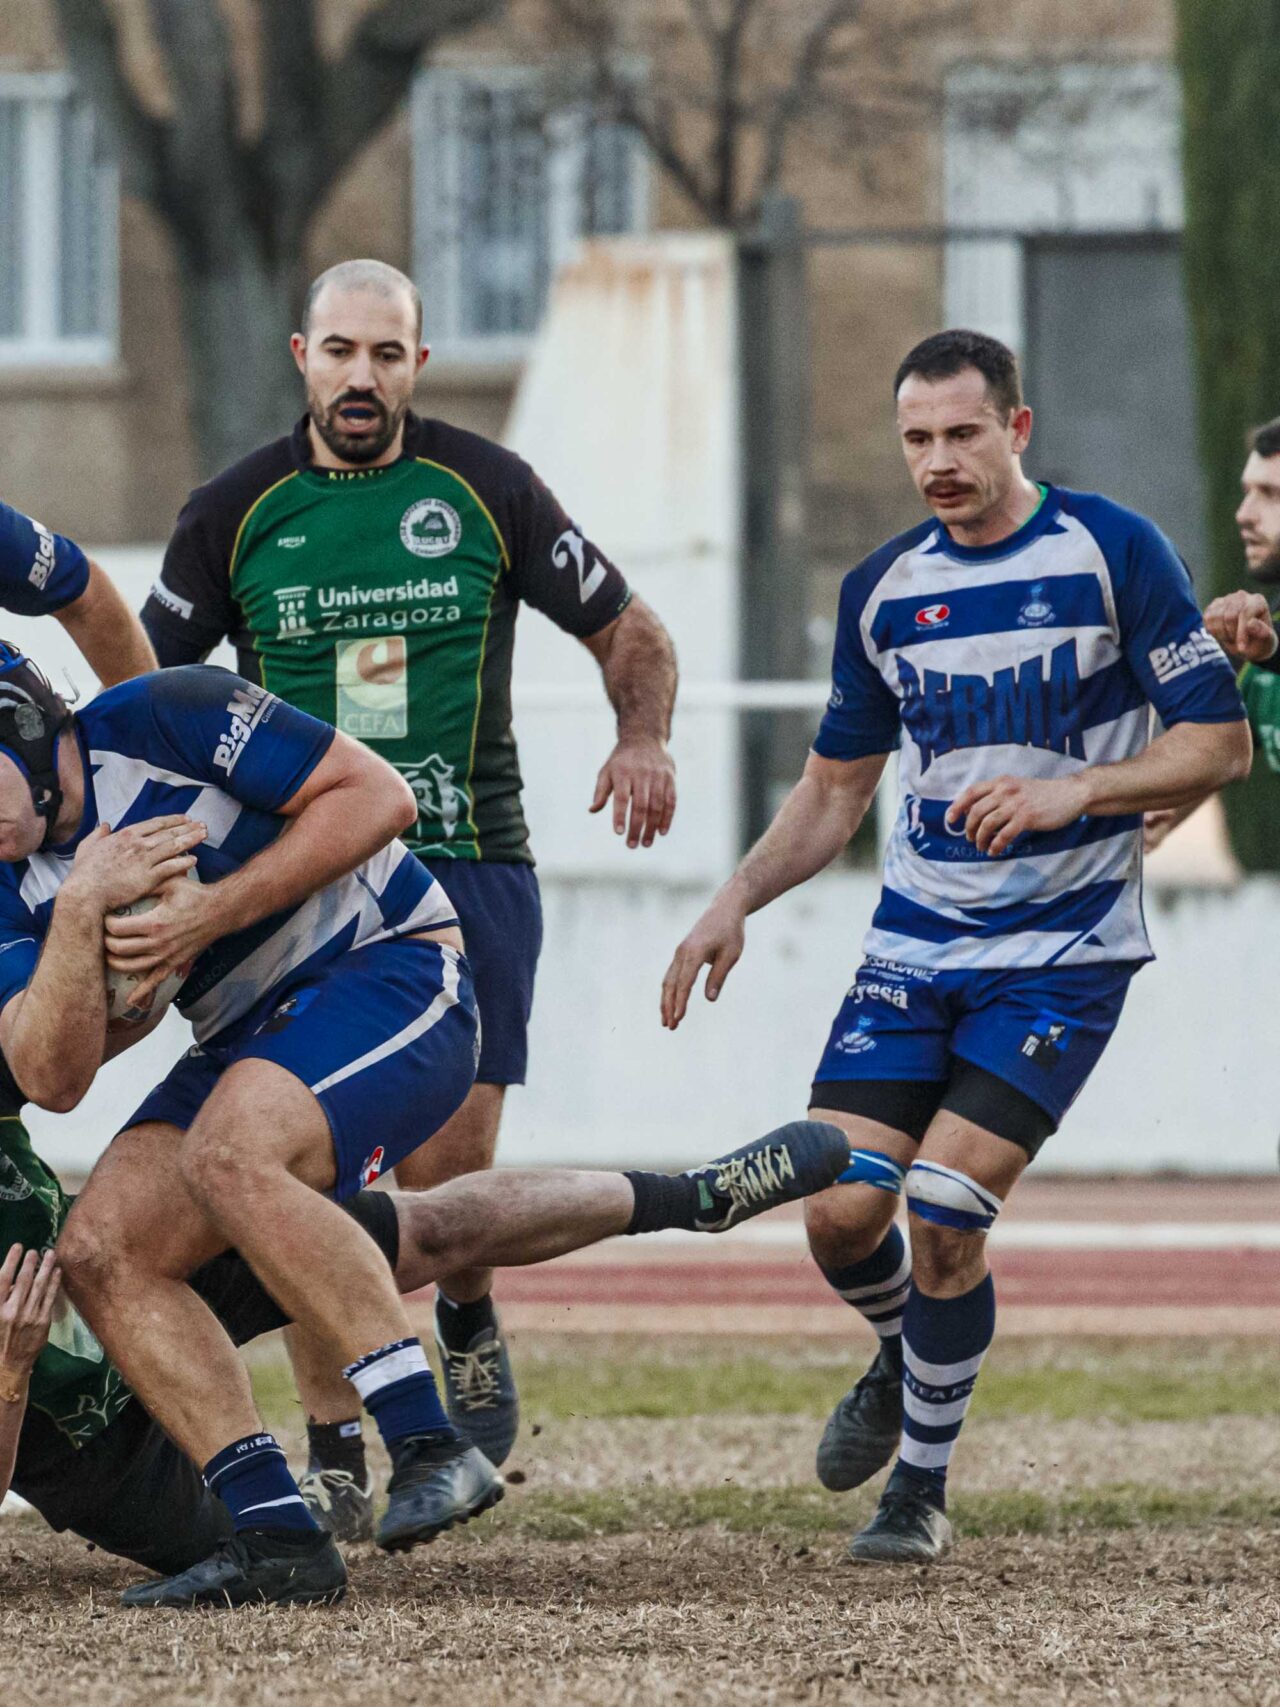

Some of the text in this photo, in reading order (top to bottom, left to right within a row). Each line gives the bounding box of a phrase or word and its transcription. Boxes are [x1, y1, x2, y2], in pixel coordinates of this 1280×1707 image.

[318, 576, 459, 608] Universidad
[321, 604, 461, 631] Zaragoza
[344, 713, 401, 734] CEFA
